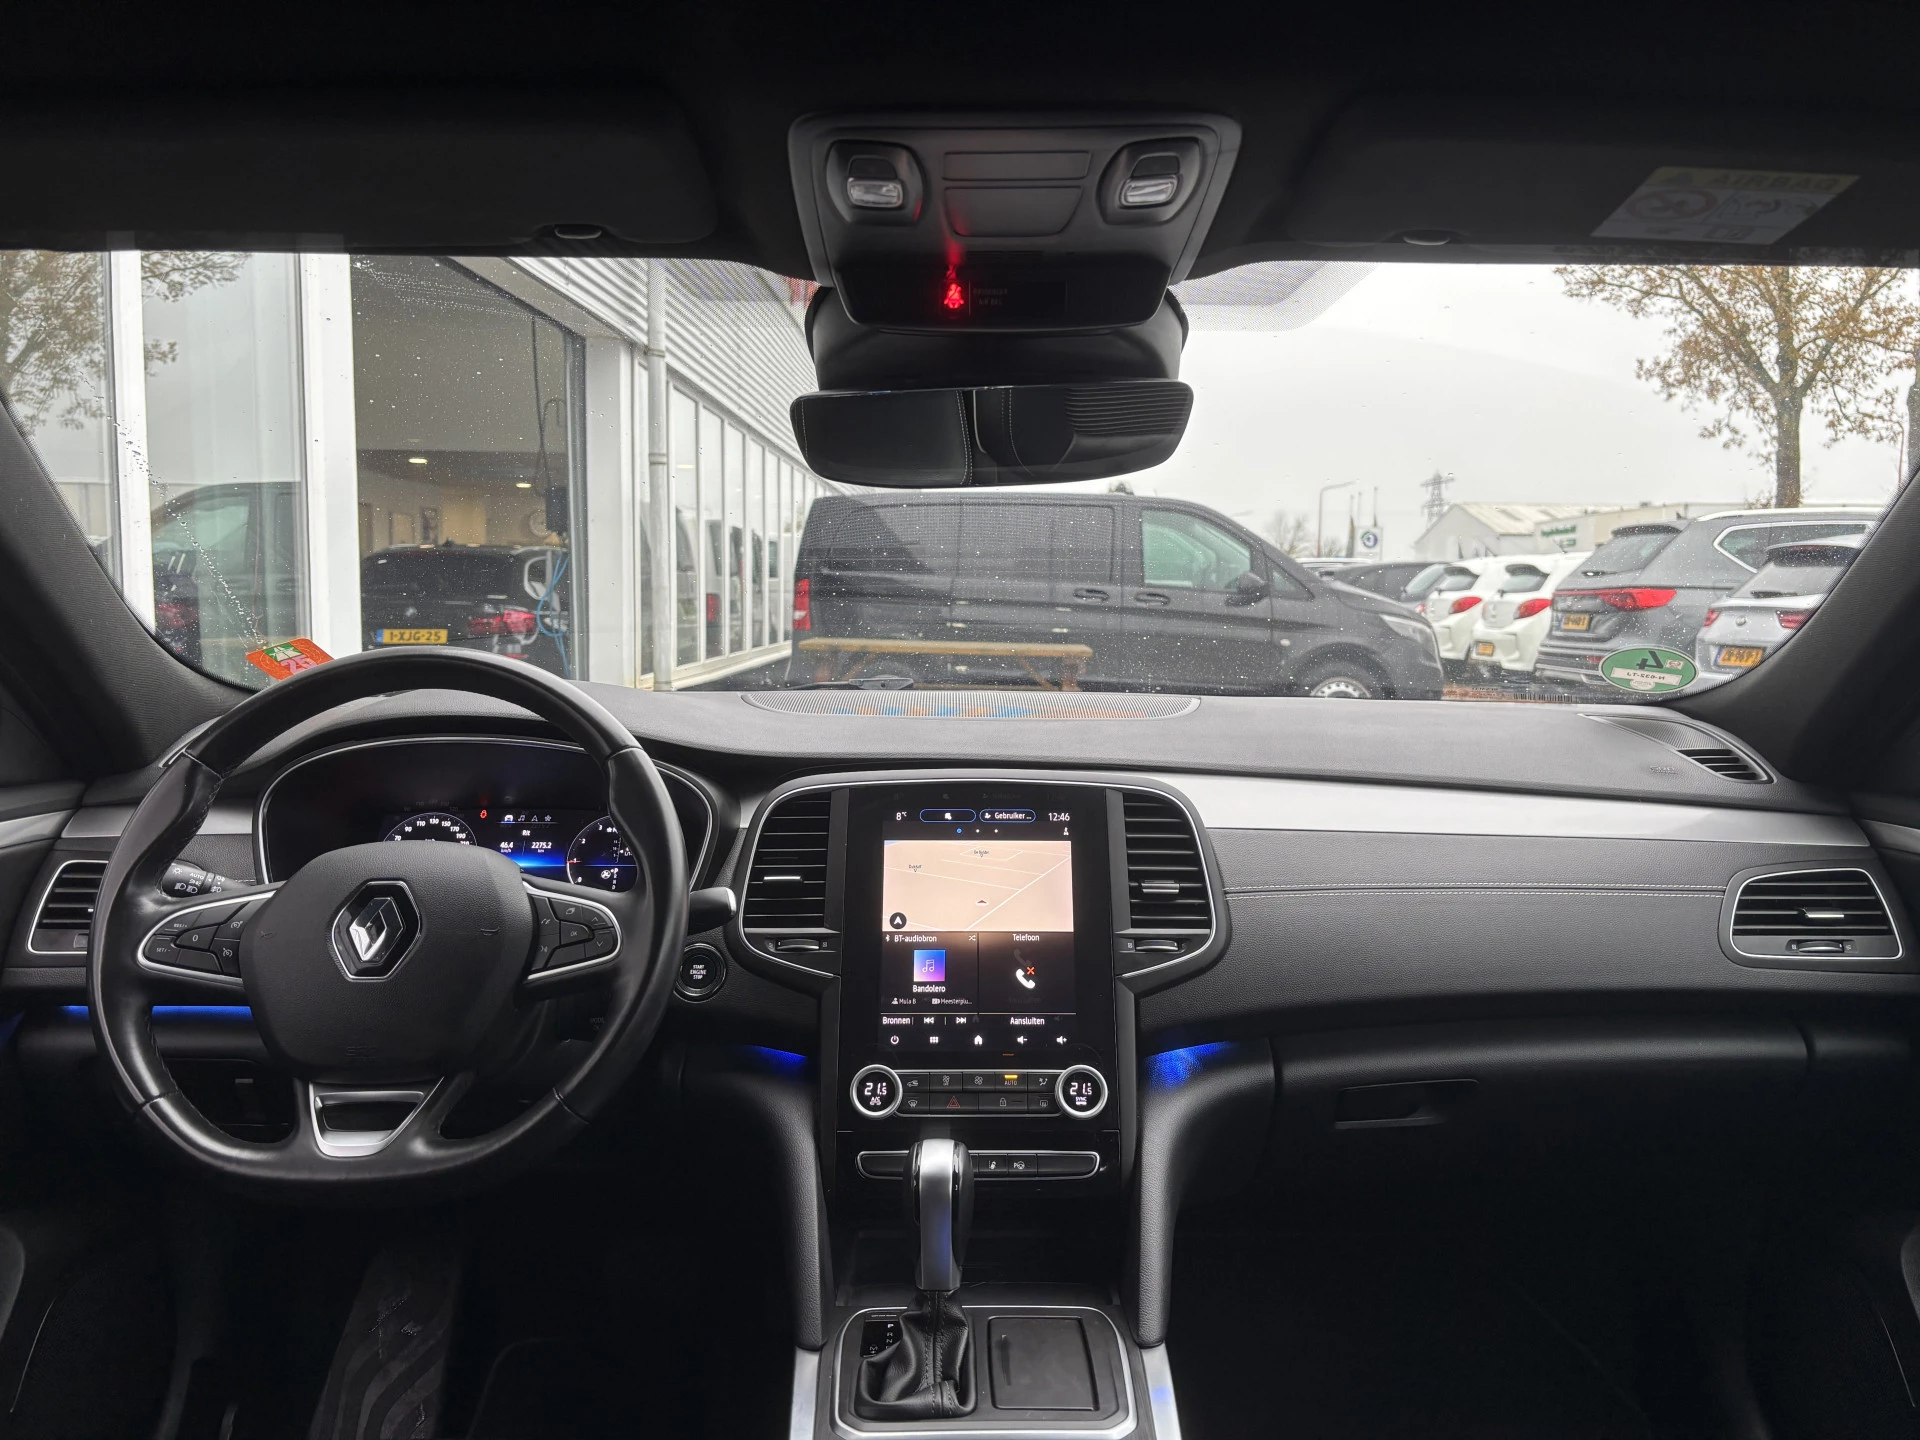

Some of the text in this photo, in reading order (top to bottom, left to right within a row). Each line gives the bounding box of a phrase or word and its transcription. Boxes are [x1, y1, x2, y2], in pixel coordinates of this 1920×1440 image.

[1709, 172, 1842, 191] AIRBAG
[1048, 813, 1070, 822] 12:46
[894, 934, 937, 943] BT-audiobron
[1013, 934, 1040, 942] Telefoon
[882, 1016, 910, 1024] Bronnen
[1010, 1016, 1045, 1025] Aansluiten
